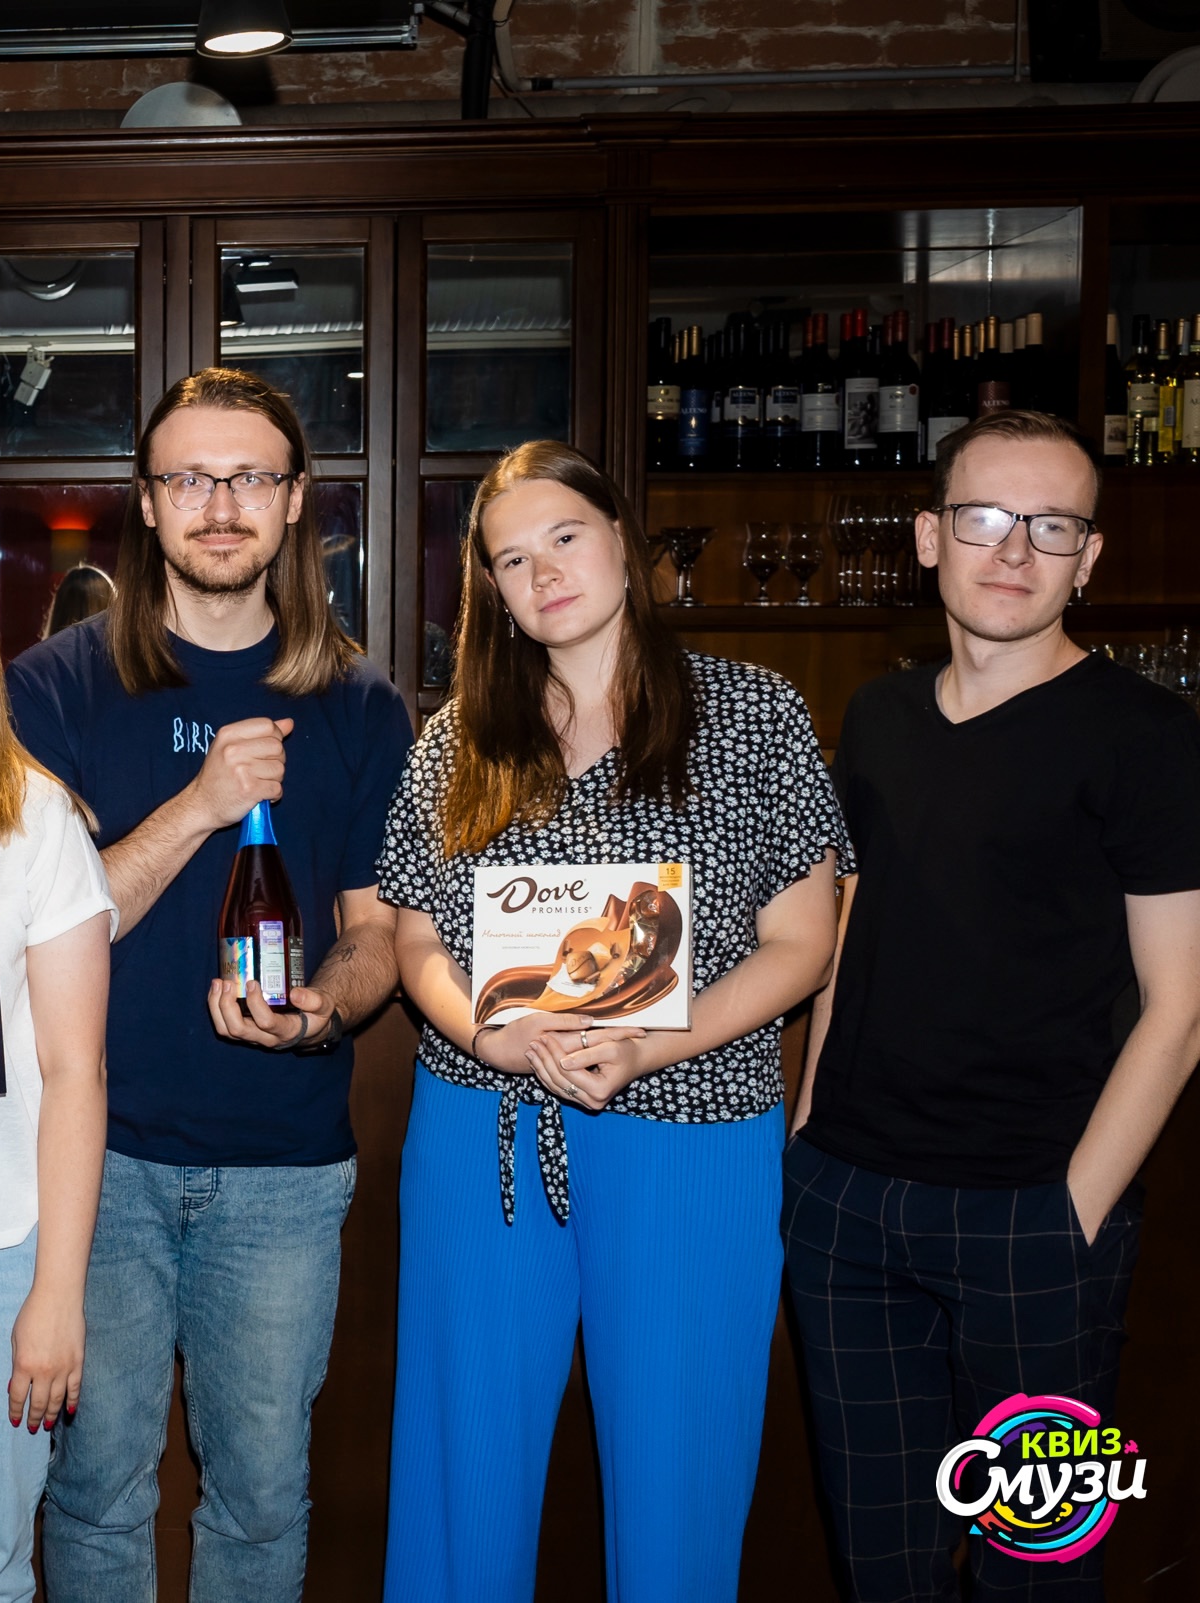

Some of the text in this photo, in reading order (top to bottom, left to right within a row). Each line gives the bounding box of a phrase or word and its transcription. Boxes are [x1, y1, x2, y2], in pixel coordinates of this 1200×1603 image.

[666, 867, 675, 875] 15
[486, 876, 589, 913] Dove
[532, 906, 589, 914] PROMISES
